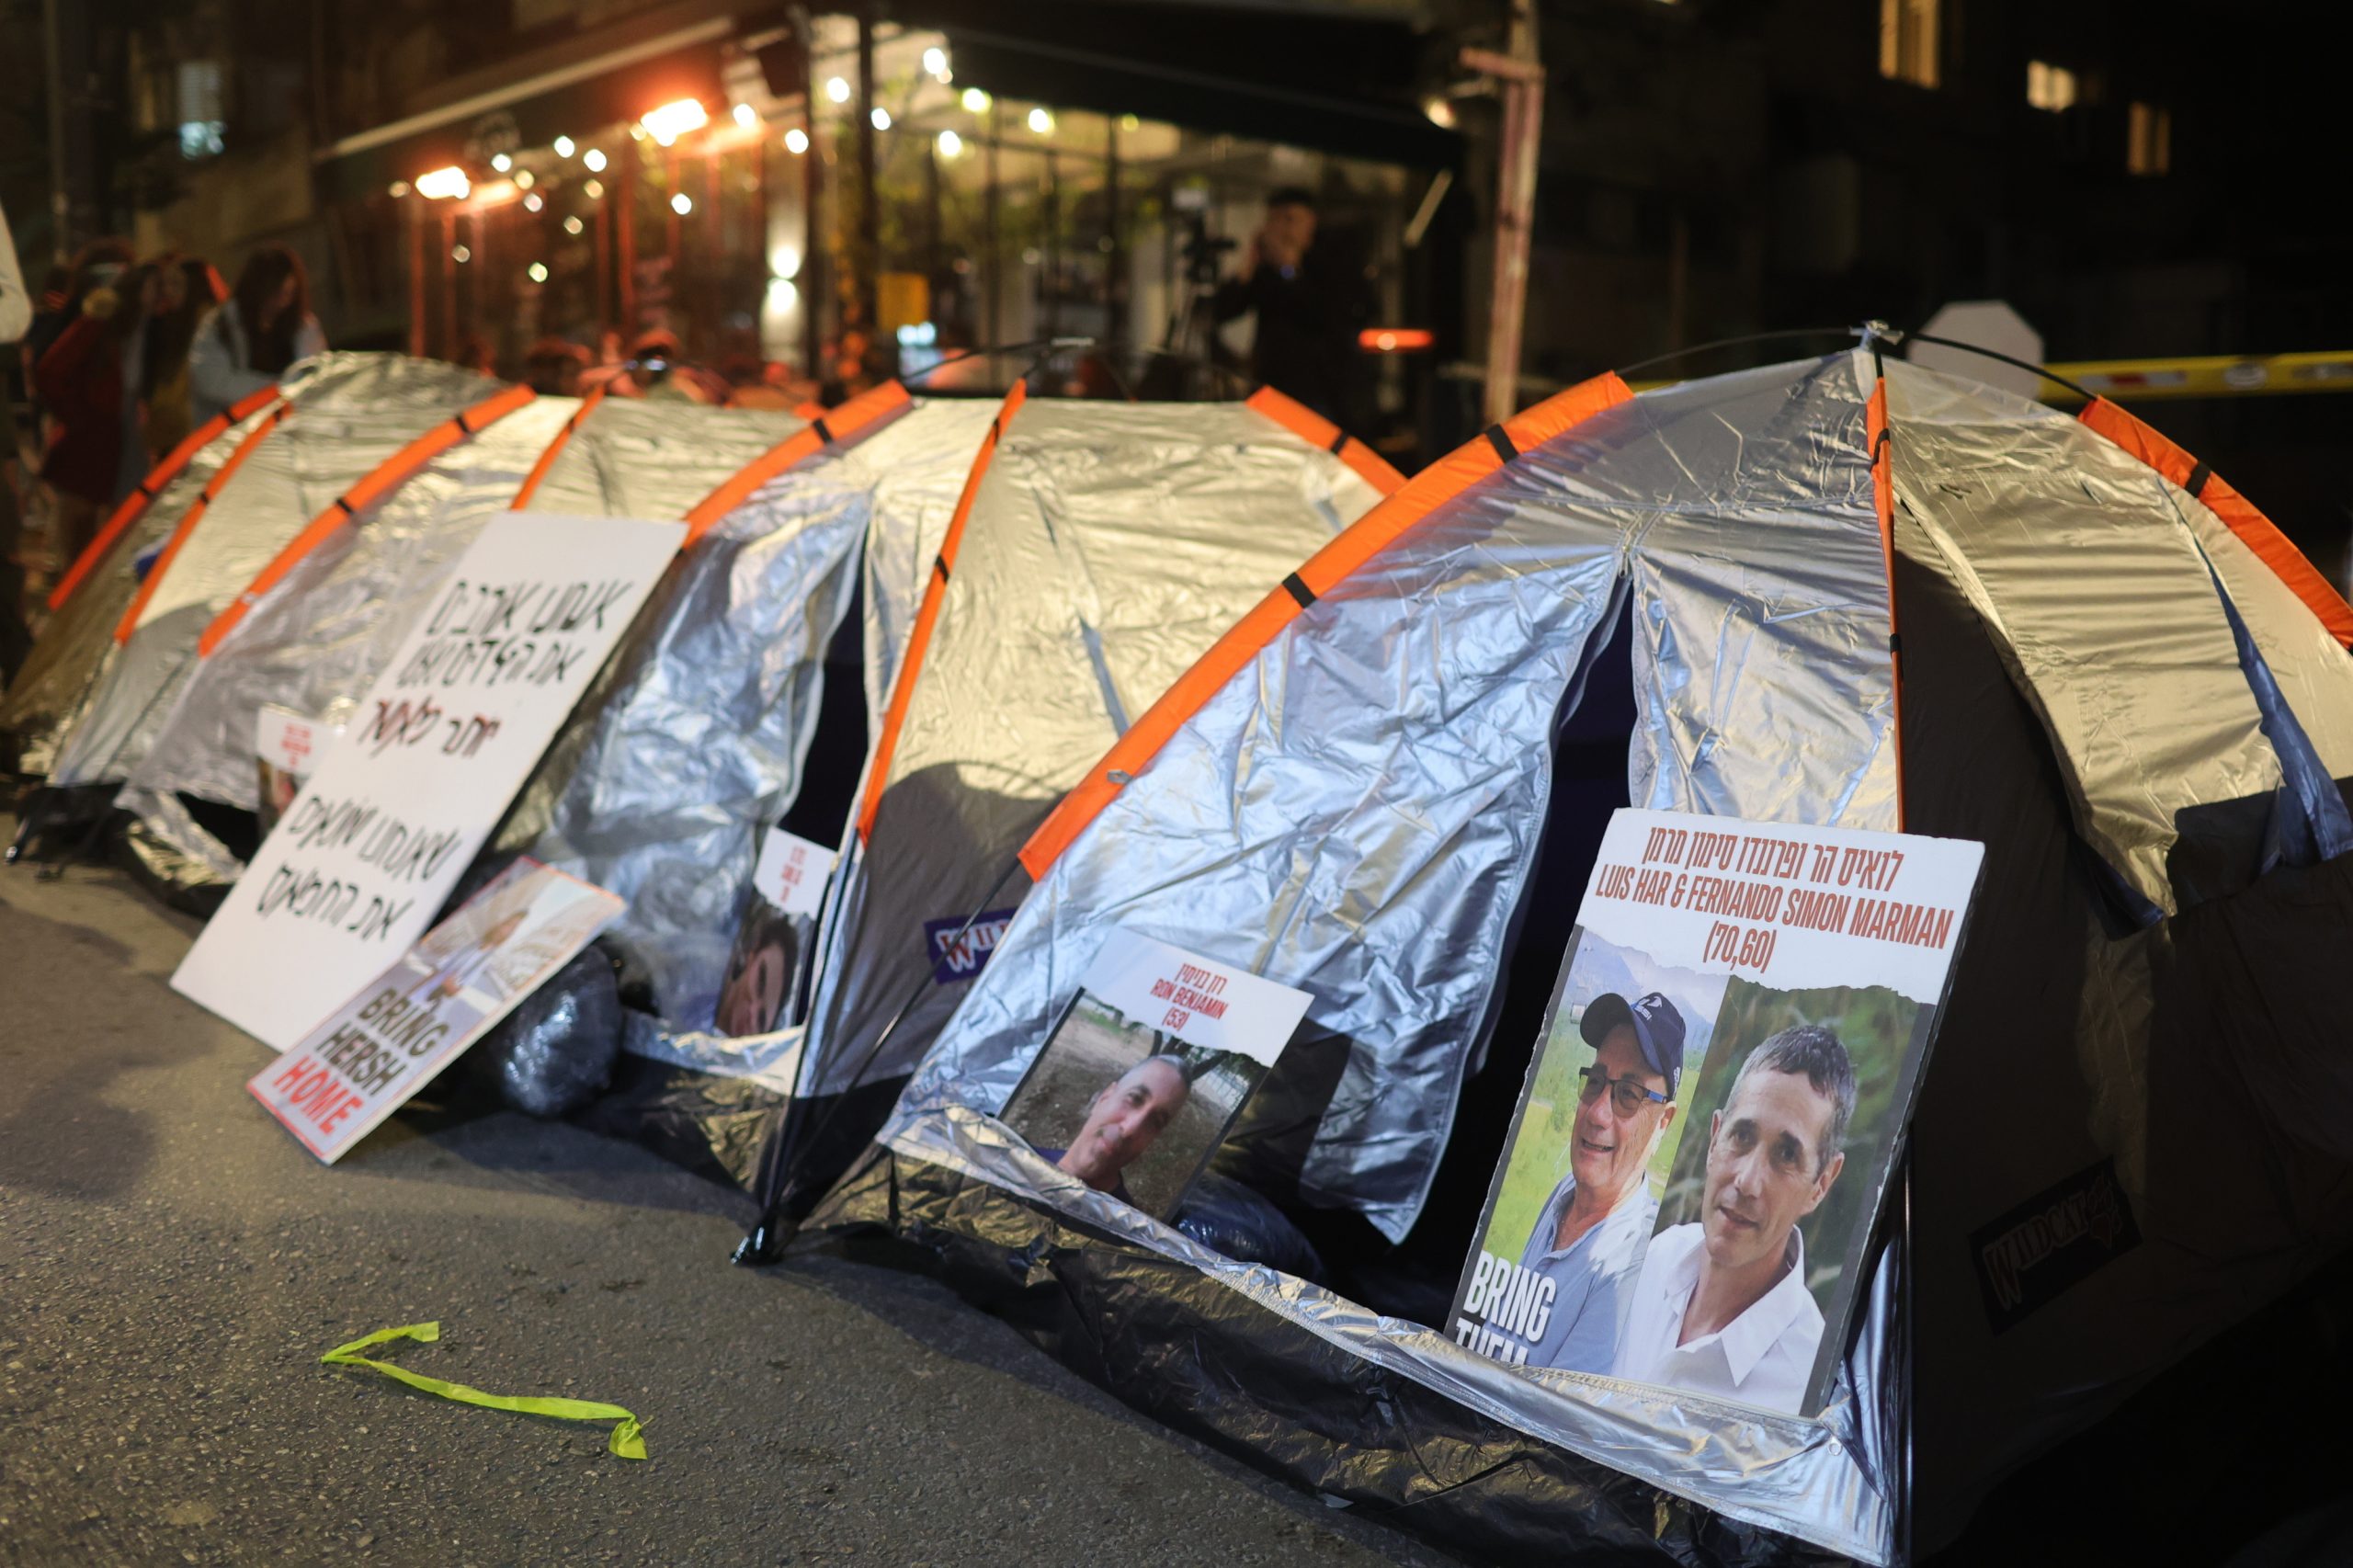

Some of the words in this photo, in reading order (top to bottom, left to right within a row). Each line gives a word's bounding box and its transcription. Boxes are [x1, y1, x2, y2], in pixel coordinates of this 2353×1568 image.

[527, 642, 586, 686] את
[1642, 827, 1688, 865] מרמן
[1688, 832, 1737, 871] סימון
[1736, 836, 1809, 881] ופרננדו
[1811, 844, 1838, 884] הר
[1838, 847, 1904, 892] לואיס
[1596, 864, 1636, 900] LUIS
[1632, 869, 1669, 906] HAR
[1669, 874, 1688, 908] &
[1685, 875, 1784, 924] FERNANDO
[1781, 888, 1852, 934] SIMON
[1847, 897, 1955, 950] MARMAN
[1701, 920, 1778, 974] (70,60)
[1174, 962, 1211, 989] בנימין
[1205, 974, 1228, 996] רון
[1150, 978, 1177, 1002] RON
[1172, 986, 1230, 1021] BENJAMIN
[1162, 1006, 1190, 1032] (53)
[358, 986, 449, 1058] BRING
[314, 1020, 407, 1097] HERSH
[272, 1055, 364, 1137] HOME
[1462, 1249, 1558, 1343] BRING
